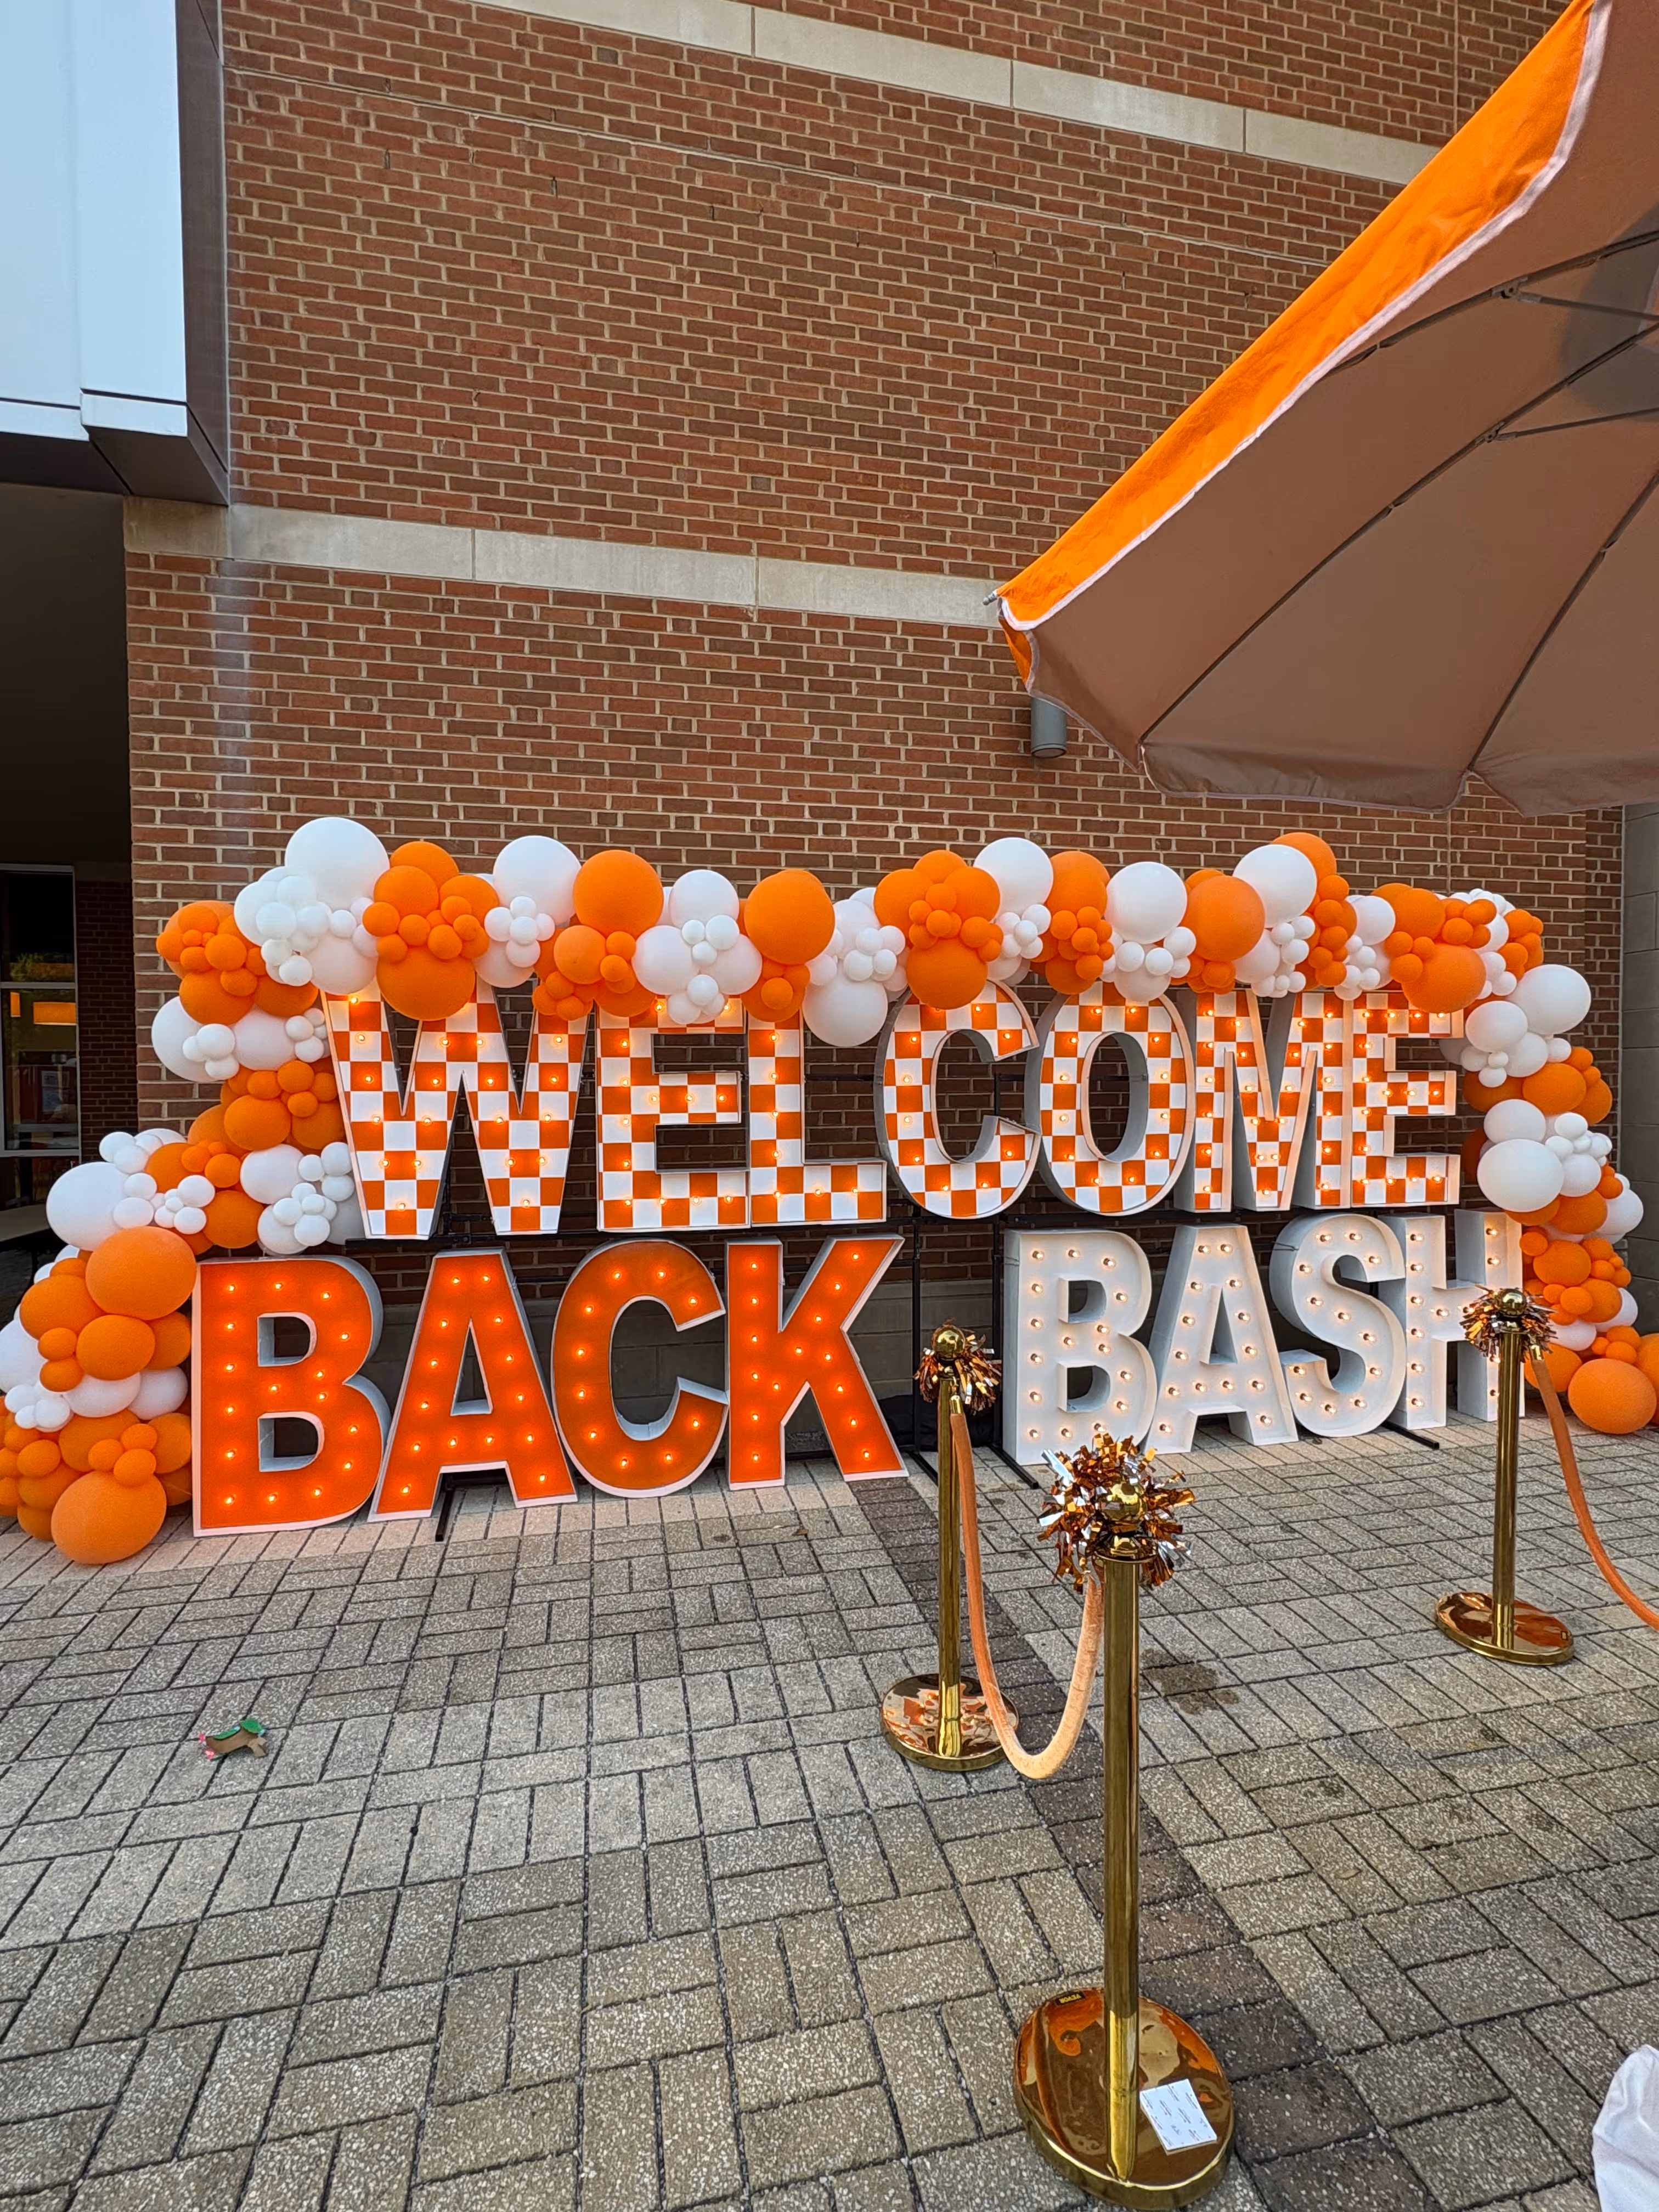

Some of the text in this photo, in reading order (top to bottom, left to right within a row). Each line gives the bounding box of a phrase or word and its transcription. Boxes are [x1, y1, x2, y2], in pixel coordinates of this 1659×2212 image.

[321, 977, 1463, 1240] WELCOME
[192, 1209, 1525, 1536] BACK BASH
